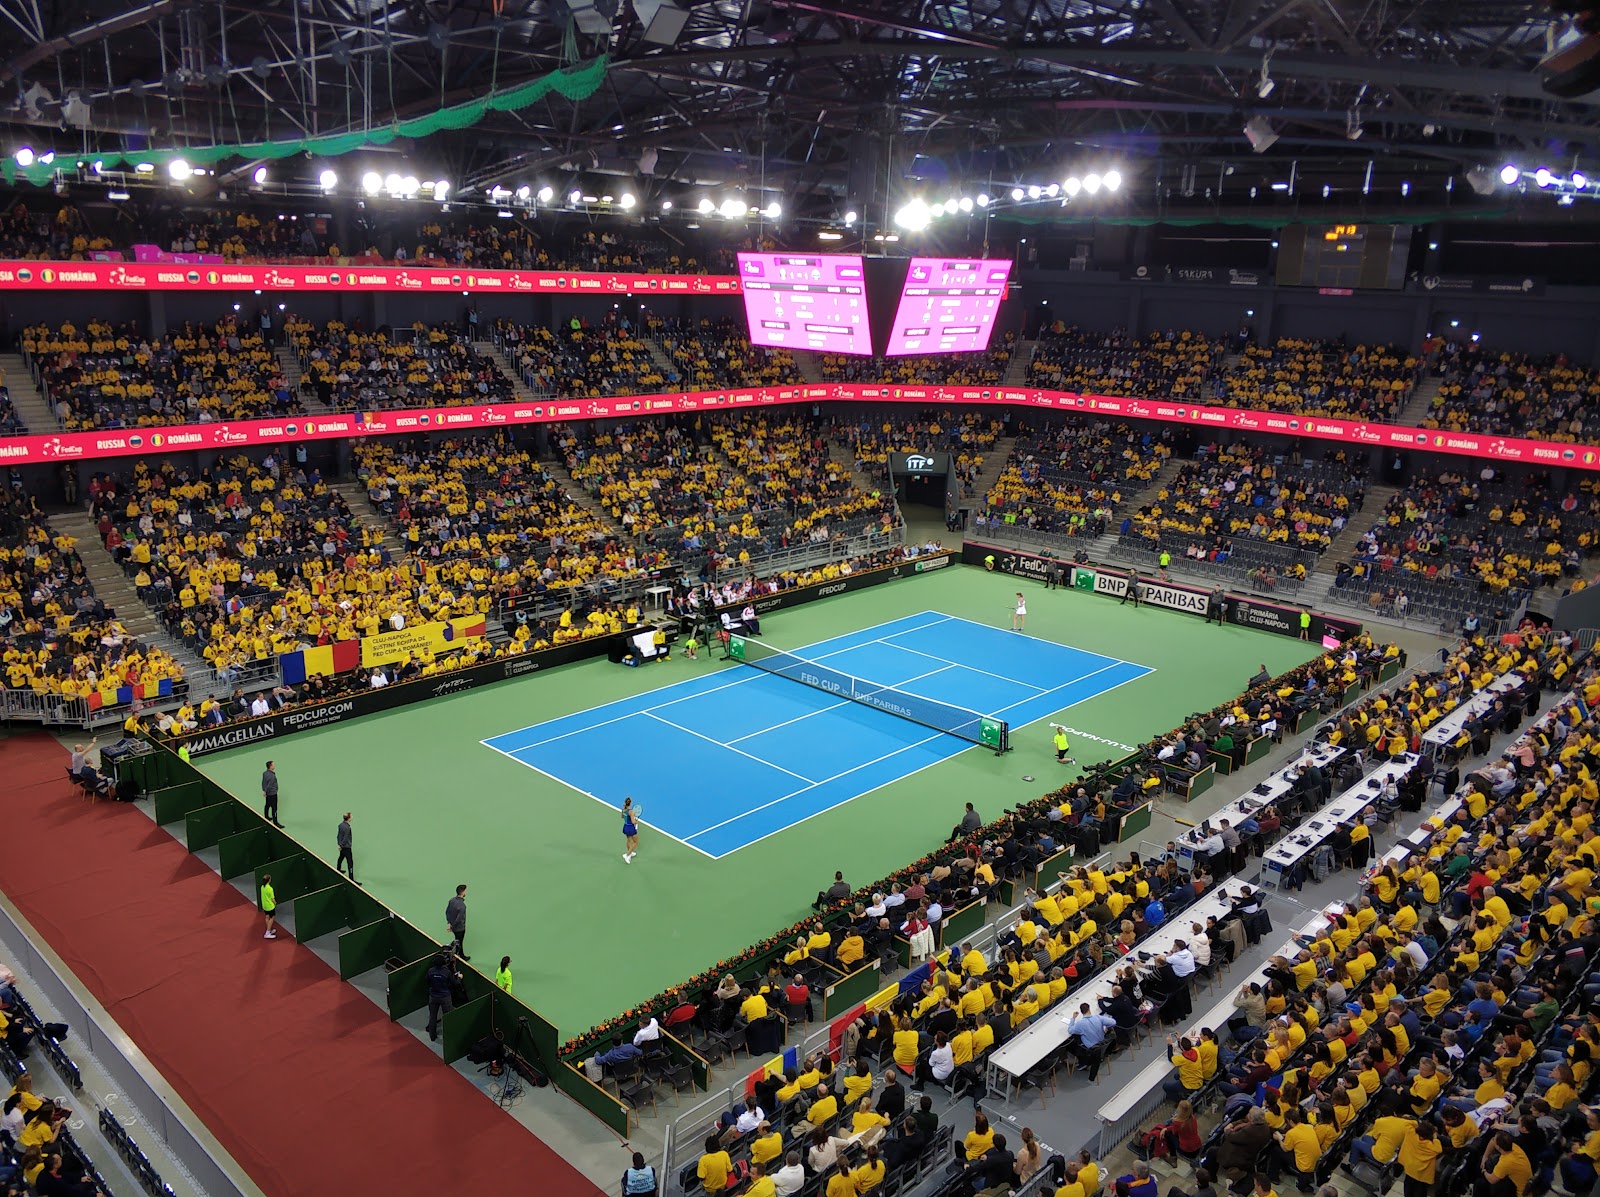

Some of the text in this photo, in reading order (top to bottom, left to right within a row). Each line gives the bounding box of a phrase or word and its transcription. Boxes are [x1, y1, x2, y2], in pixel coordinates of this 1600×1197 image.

[59, 271, 96, 282] ROMÂNIA
[125, 276, 146, 284] FedCup
[158, 272, 184, 283] RUSSIA
[222, 273, 254, 284] ROMÂNIA
[278, 277, 294, 285] FedCup
[305, 275, 327, 284] RUSSIA
[360, 276, 387, 284] ROMÂNIA
[430, 277, 450, 286] RUSSIA
[478, 277, 501, 286] ROMÂNIA
[540, 279, 556, 288] RUSSIA
[580, 280, 600, 288] ROMÂNIA
[634, 280, 649, 288] RUSSIA
[669, 281, 687, 289] ROMÂNIA
[716, 282, 730, 290] RUSSIA
[61, 446, 82, 454] FedCup
[97, 439, 126, 450] RUSSIA
[168, 433, 202, 444] ROMÂNIA
[229, 433, 247, 441] FedCup
[259, 427, 283, 438] RUSSIA
[318, 422, 348, 432] ROMÂNIA
[396, 418, 417, 427] RUSSIA
[448, 414, 473, 423] ROMÂNIA
[514, 410, 532, 418] RUSSIA
[558, 406, 580, 415] ROMÂNIA
[654, 400, 672, 408] ROMÂNIA
[703, 397, 716, 405] RUSSIA
[1006, 392, 1026, 400] ROMÂNIA
[1060, 398, 1074, 406] RUSSIA
[1099, 402, 1120, 410] ROMÂNIA
[1158, 408, 1174, 416] RUSSIA
[1202, 412, 1226, 422] ROMÂNIA
[1268, 420, 1286, 428] RUSSIA
[1317, 425, 1344, 435] ROMÂNIA
[1391, 433, 1413, 442] RUSSIA
[1448, 440, 1478, 450] ROMÂNIA
[1504, 448, 1522, 456] FedCup
[1534, 448, 1558, 459] RUSSIA
[908, 460, 926, 468] ITF
[1020, 557, 1048, 573] FedCu
[1026, 572, 1048, 580] PARIBA
[818, 582, 847, 596] #FEDCUP
[1098, 577, 1206, 610] BNP PARIBAS
[1250, 608, 1279, 620] PRIMĂRIA
[1249, 616, 1290, 630] CLUJ-NAPOCA
[372, 632, 412, 644] CLUJ-NAPOCA
[396, 638, 418, 646] ECHIPA
[513, 663, 540, 674] CLUJ-NAPOCA
[801, 672, 820, 686] FED
[821, 680, 840, 692] CUP
[854, 690, 873, 702] BNP
[874, 698, 912, 716] PARIBAS
[283, 702, 353, 726] FEDCUP.COM
[309, 718, 329, 727] TICKETS
[329, 715, 341, 724] NOW
[204, 722, 274, 750] MAGELLAN
